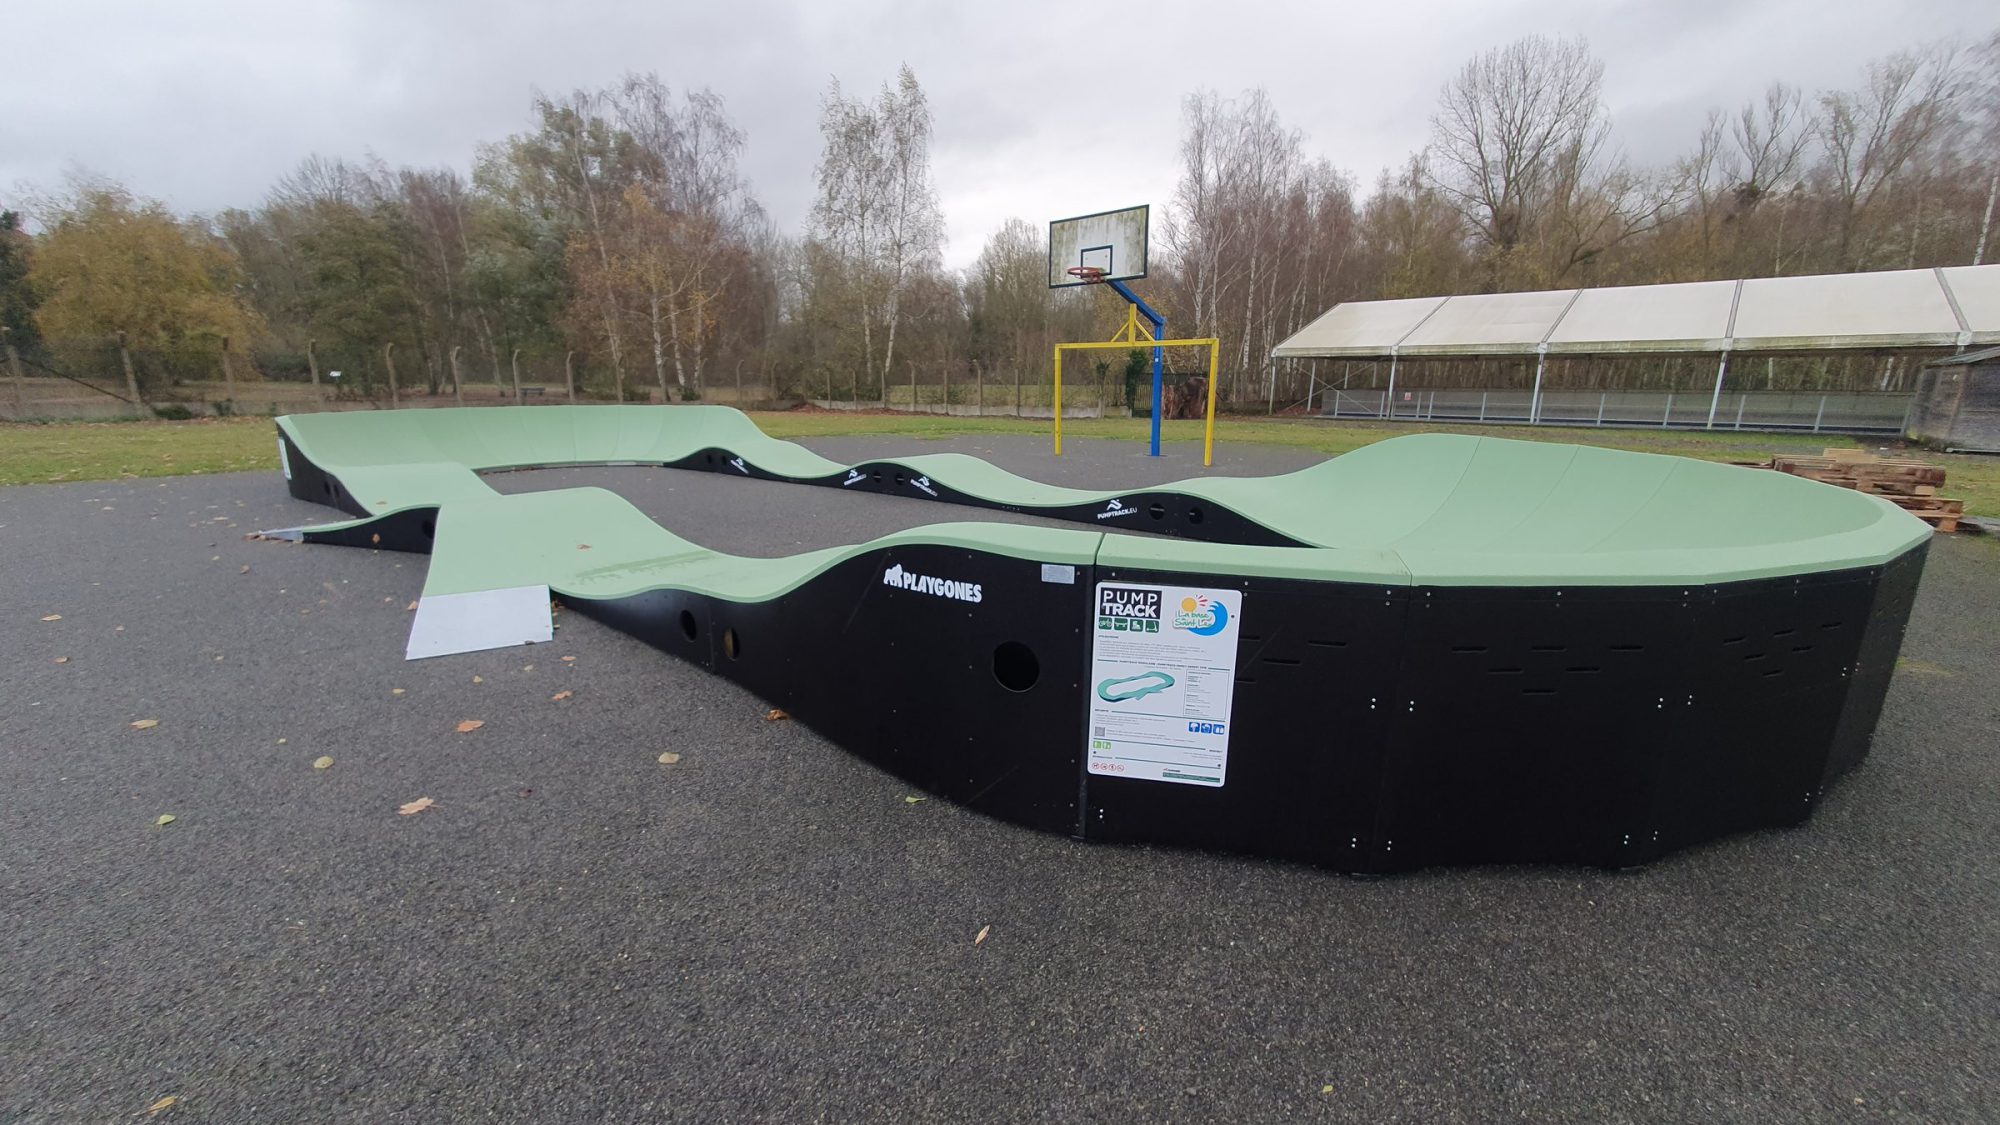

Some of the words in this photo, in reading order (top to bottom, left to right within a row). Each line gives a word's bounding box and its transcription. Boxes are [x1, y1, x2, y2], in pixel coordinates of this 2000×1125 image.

[903, 571, 983, 603] PLAYGONES
[1103, 590, 1158, 605] PUMP
[1102, 602, 1158, 618] TRACK
